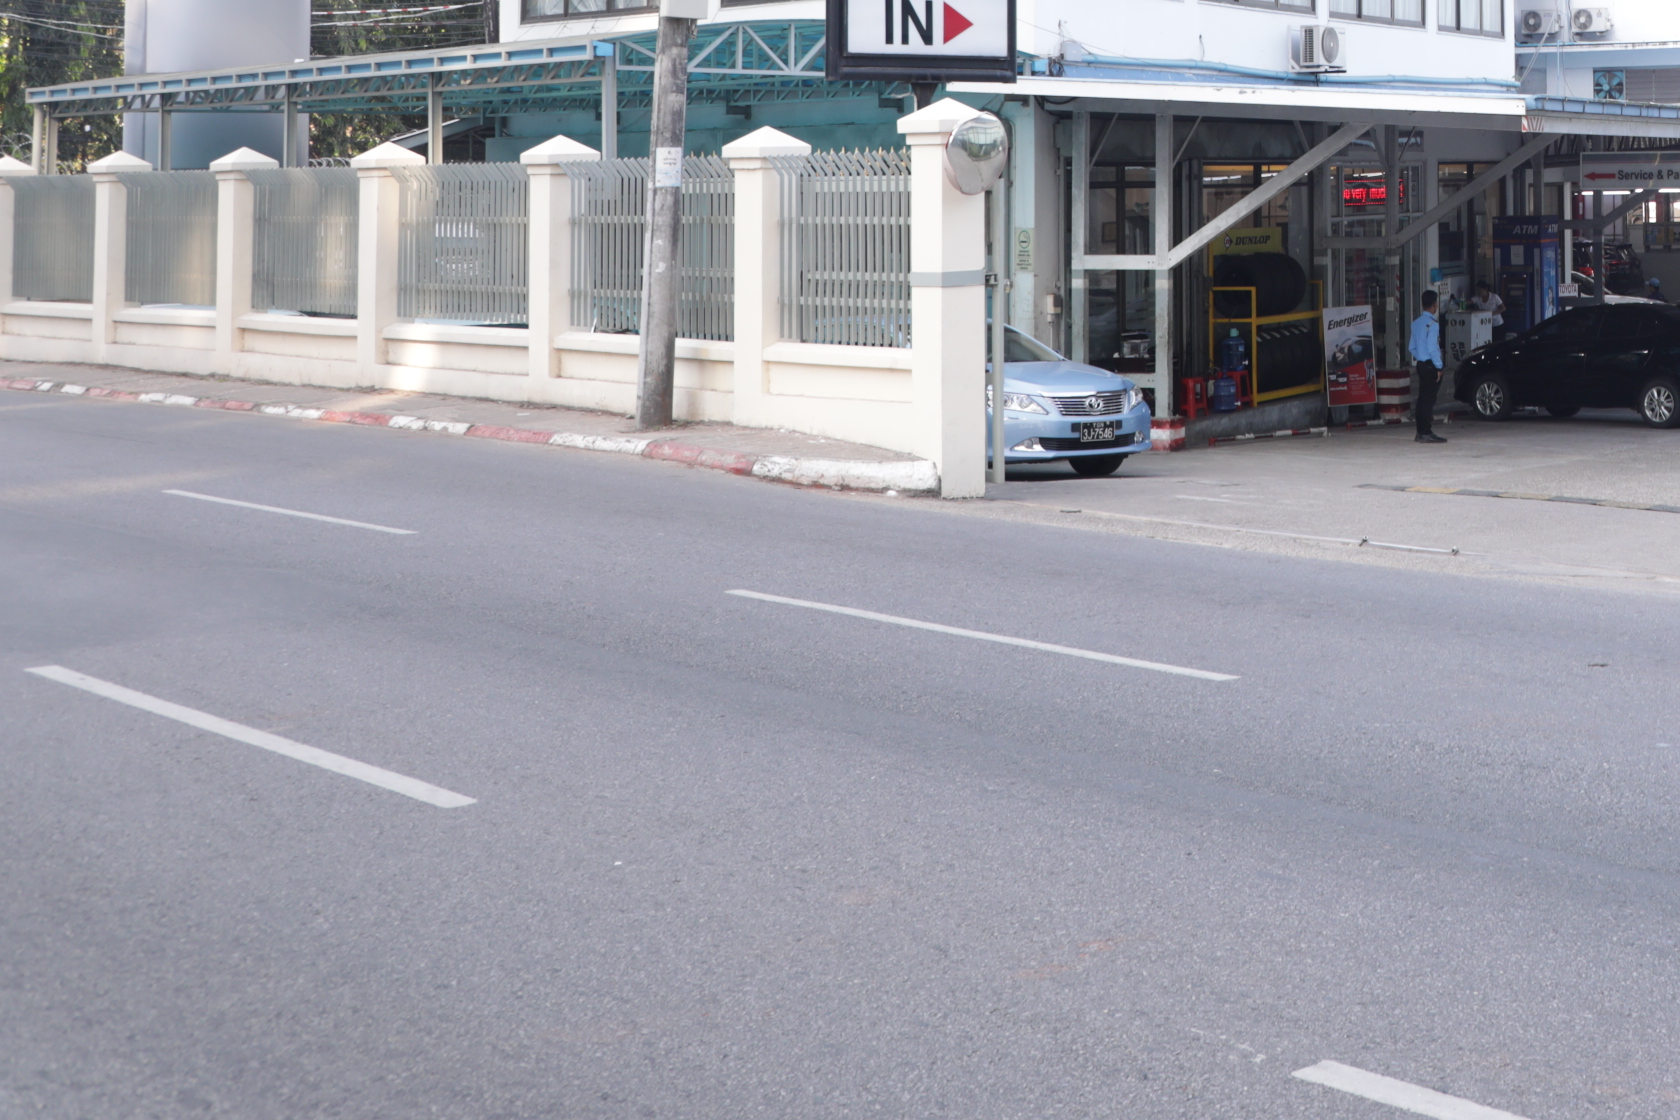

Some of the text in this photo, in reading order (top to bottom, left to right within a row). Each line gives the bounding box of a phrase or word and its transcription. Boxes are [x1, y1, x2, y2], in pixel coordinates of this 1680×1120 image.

[1617, 169, 1654, 181] Service
[1656, 170, 1664, 180] &
[1513, 224, 1539, 235] ATM
[1234, 234, 1272, 246] DUNLOP
[1559, 284, 1577, 295] TOYOTA
[1327, 311, 1369, 331] Energizer
[1082, 427, 1113, 440] 3J-7546
